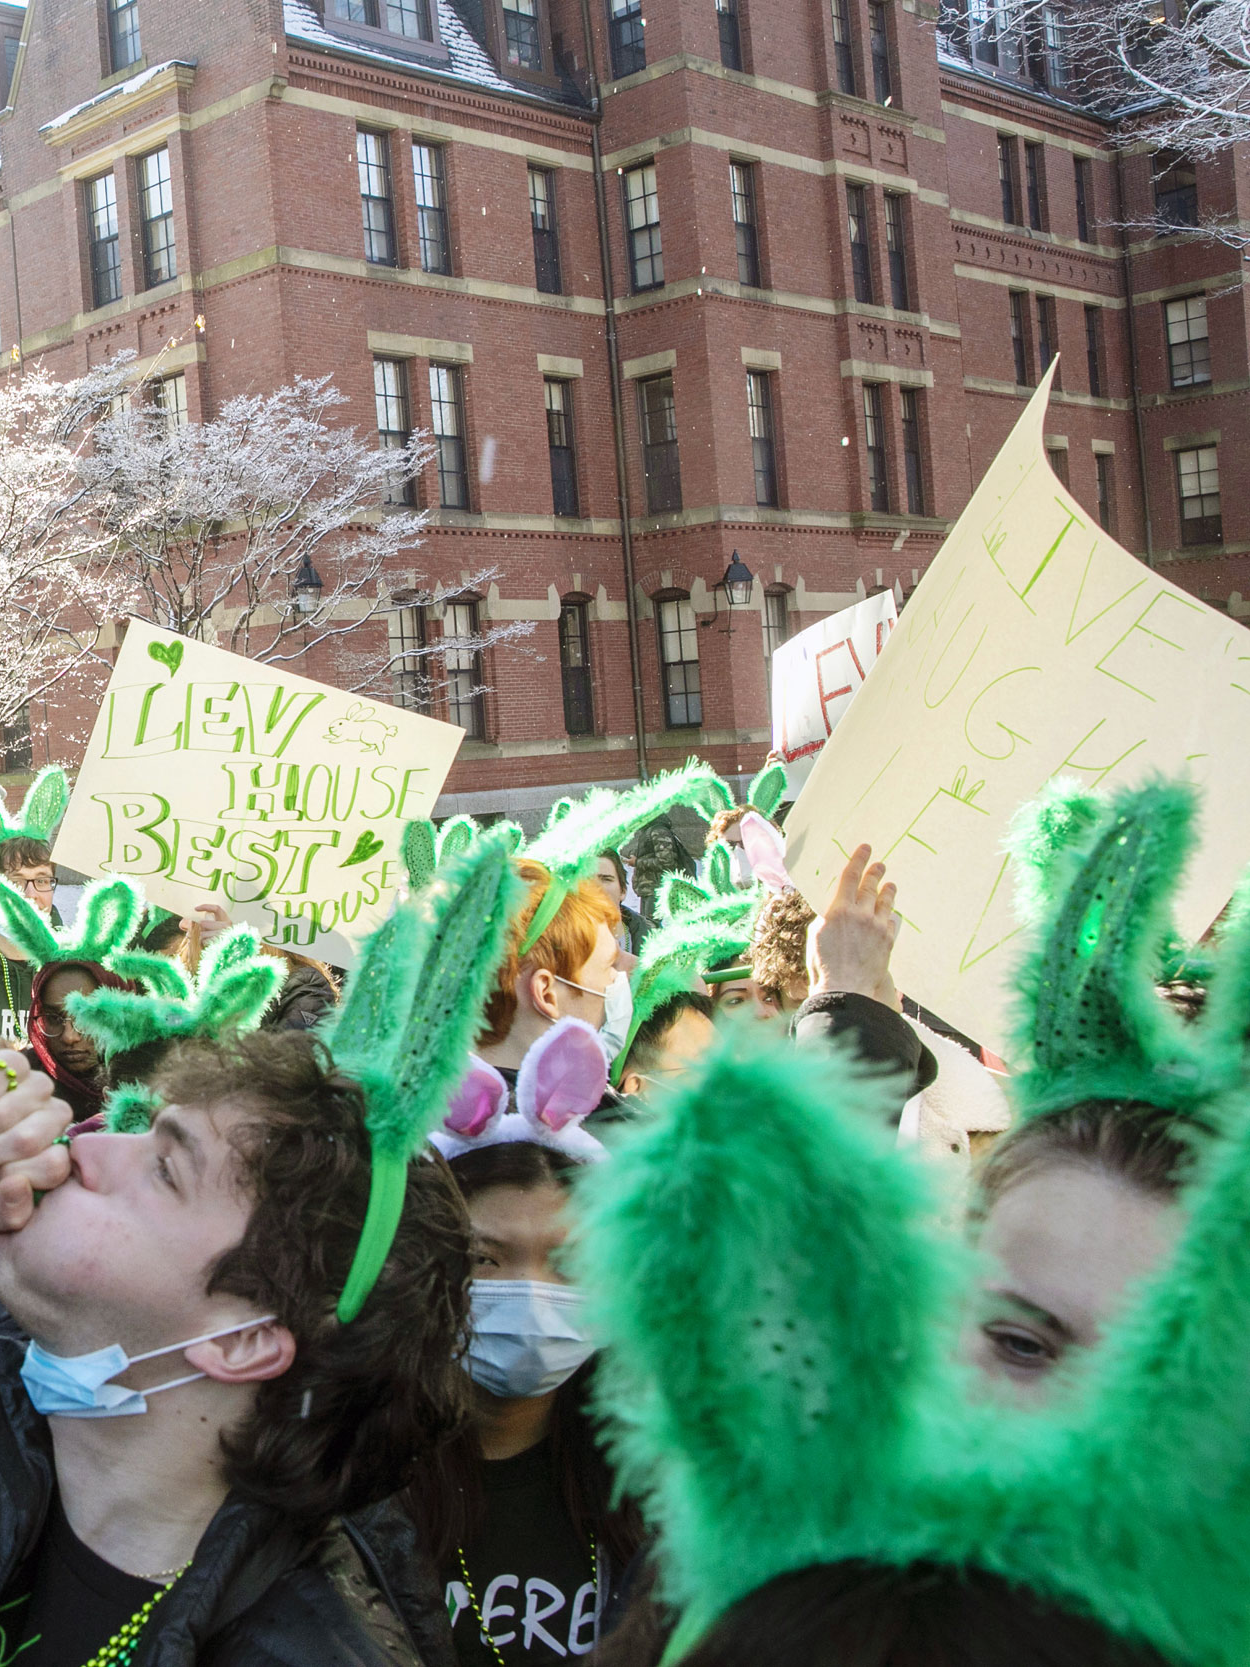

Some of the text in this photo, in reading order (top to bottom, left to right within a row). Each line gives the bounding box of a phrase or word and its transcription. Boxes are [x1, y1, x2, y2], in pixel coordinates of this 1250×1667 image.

[101, 681, 328, 759] LEV
[218, 761, 431, 822] HOUSE
[90, 791, 341, 903] BEST
[261, 860, 398, 946] HOUSE
